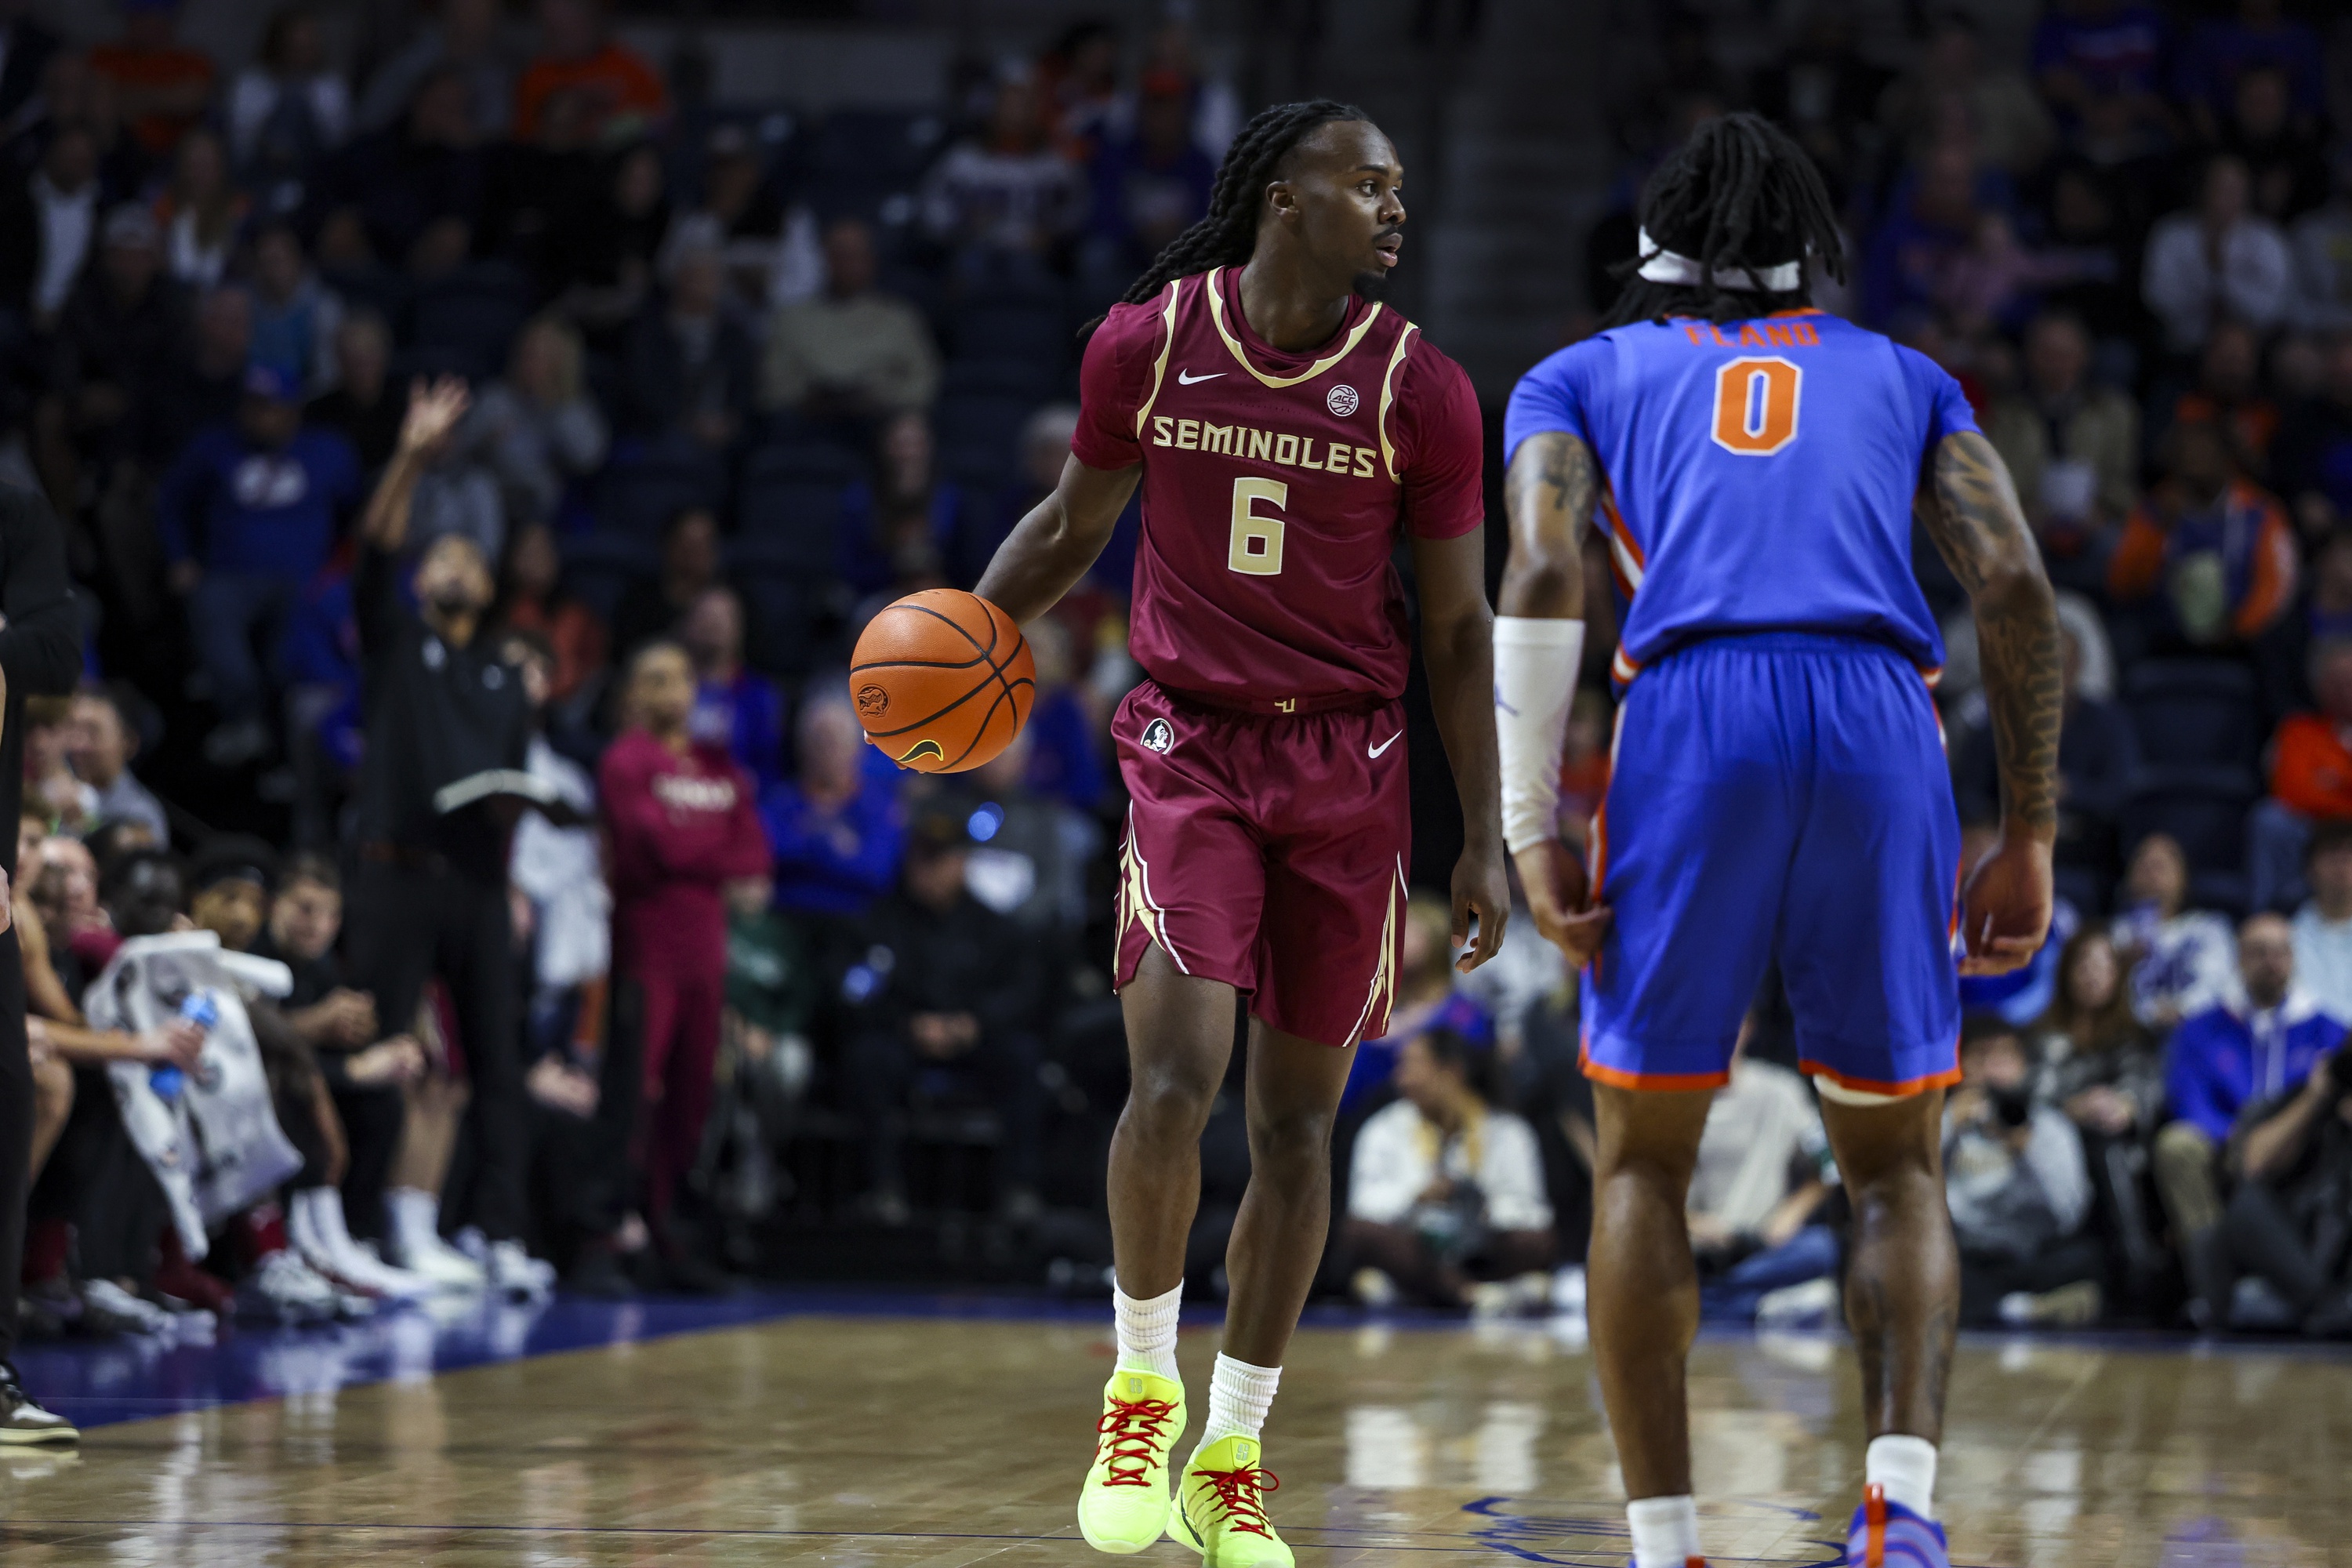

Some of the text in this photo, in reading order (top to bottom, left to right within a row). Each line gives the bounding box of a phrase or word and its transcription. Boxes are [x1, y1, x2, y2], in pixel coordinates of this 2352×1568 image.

[1684, 322, 1820, 347] FLAND
[1332, 394, 1357, 405] ACC
[1710, 355, 1803, 456] 0
[1153, 416, 1377, 478] SEMINOLES
[1228, 477, 1288, 576] 6
